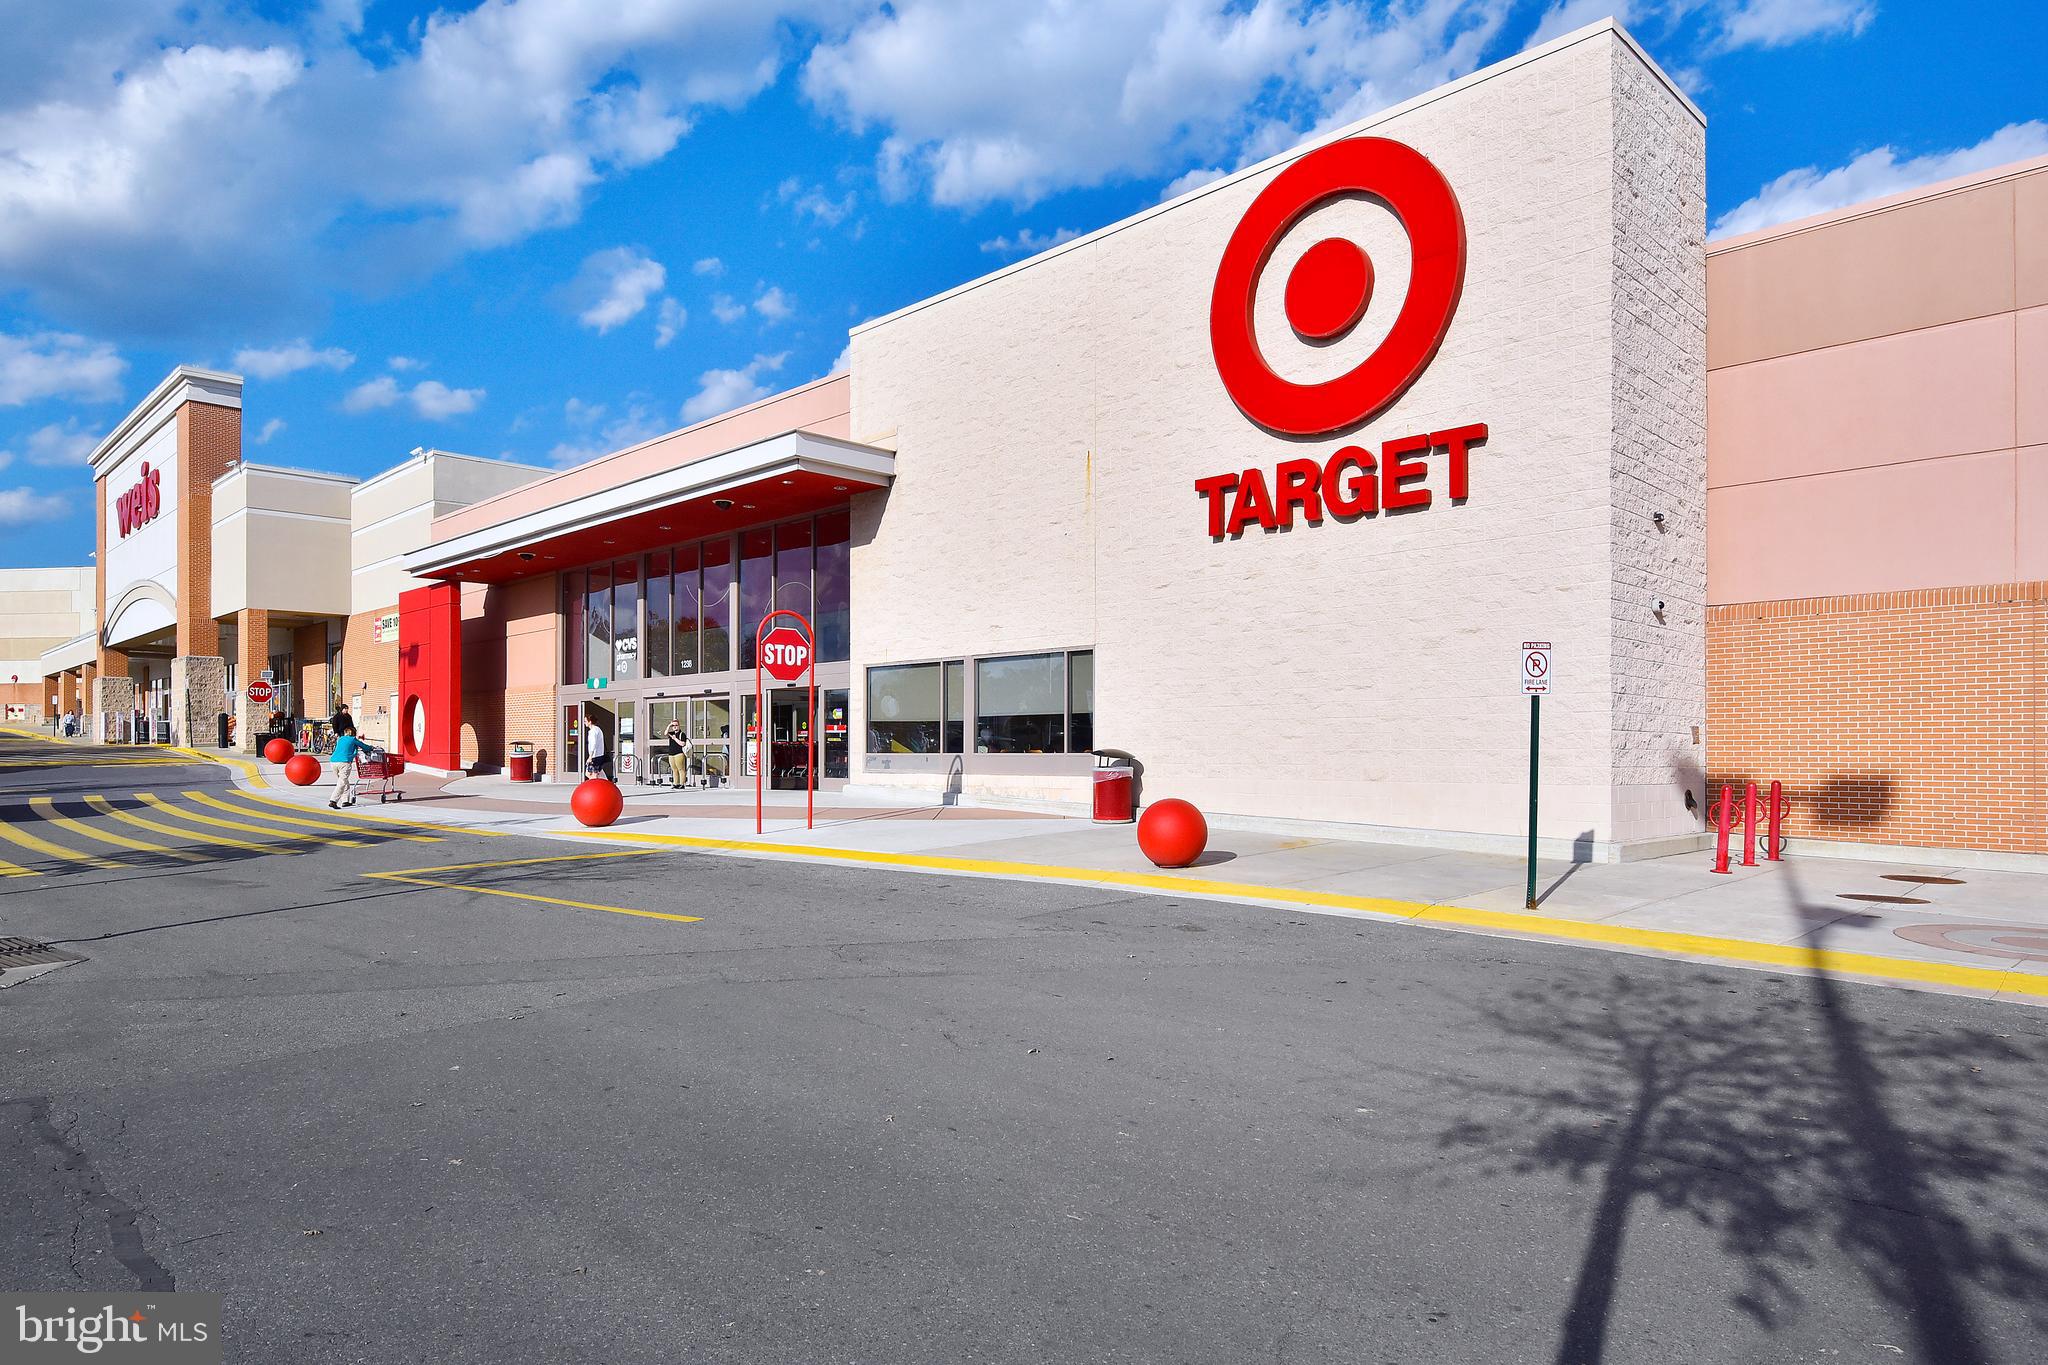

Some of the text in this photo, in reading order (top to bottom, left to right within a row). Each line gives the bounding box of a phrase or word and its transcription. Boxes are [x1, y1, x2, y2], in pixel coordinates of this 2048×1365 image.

[1195, 423, 1488, 540] TARGET
[116, 461, 160, 538] weis
[381, 618, 392, 629] SAVE
[622, 637, 637, 651] CVS
[616, 652, 637, 662] pharmacy
[764, 643, 807, 666] STOP
[249, 687, 271, 697] STOP
